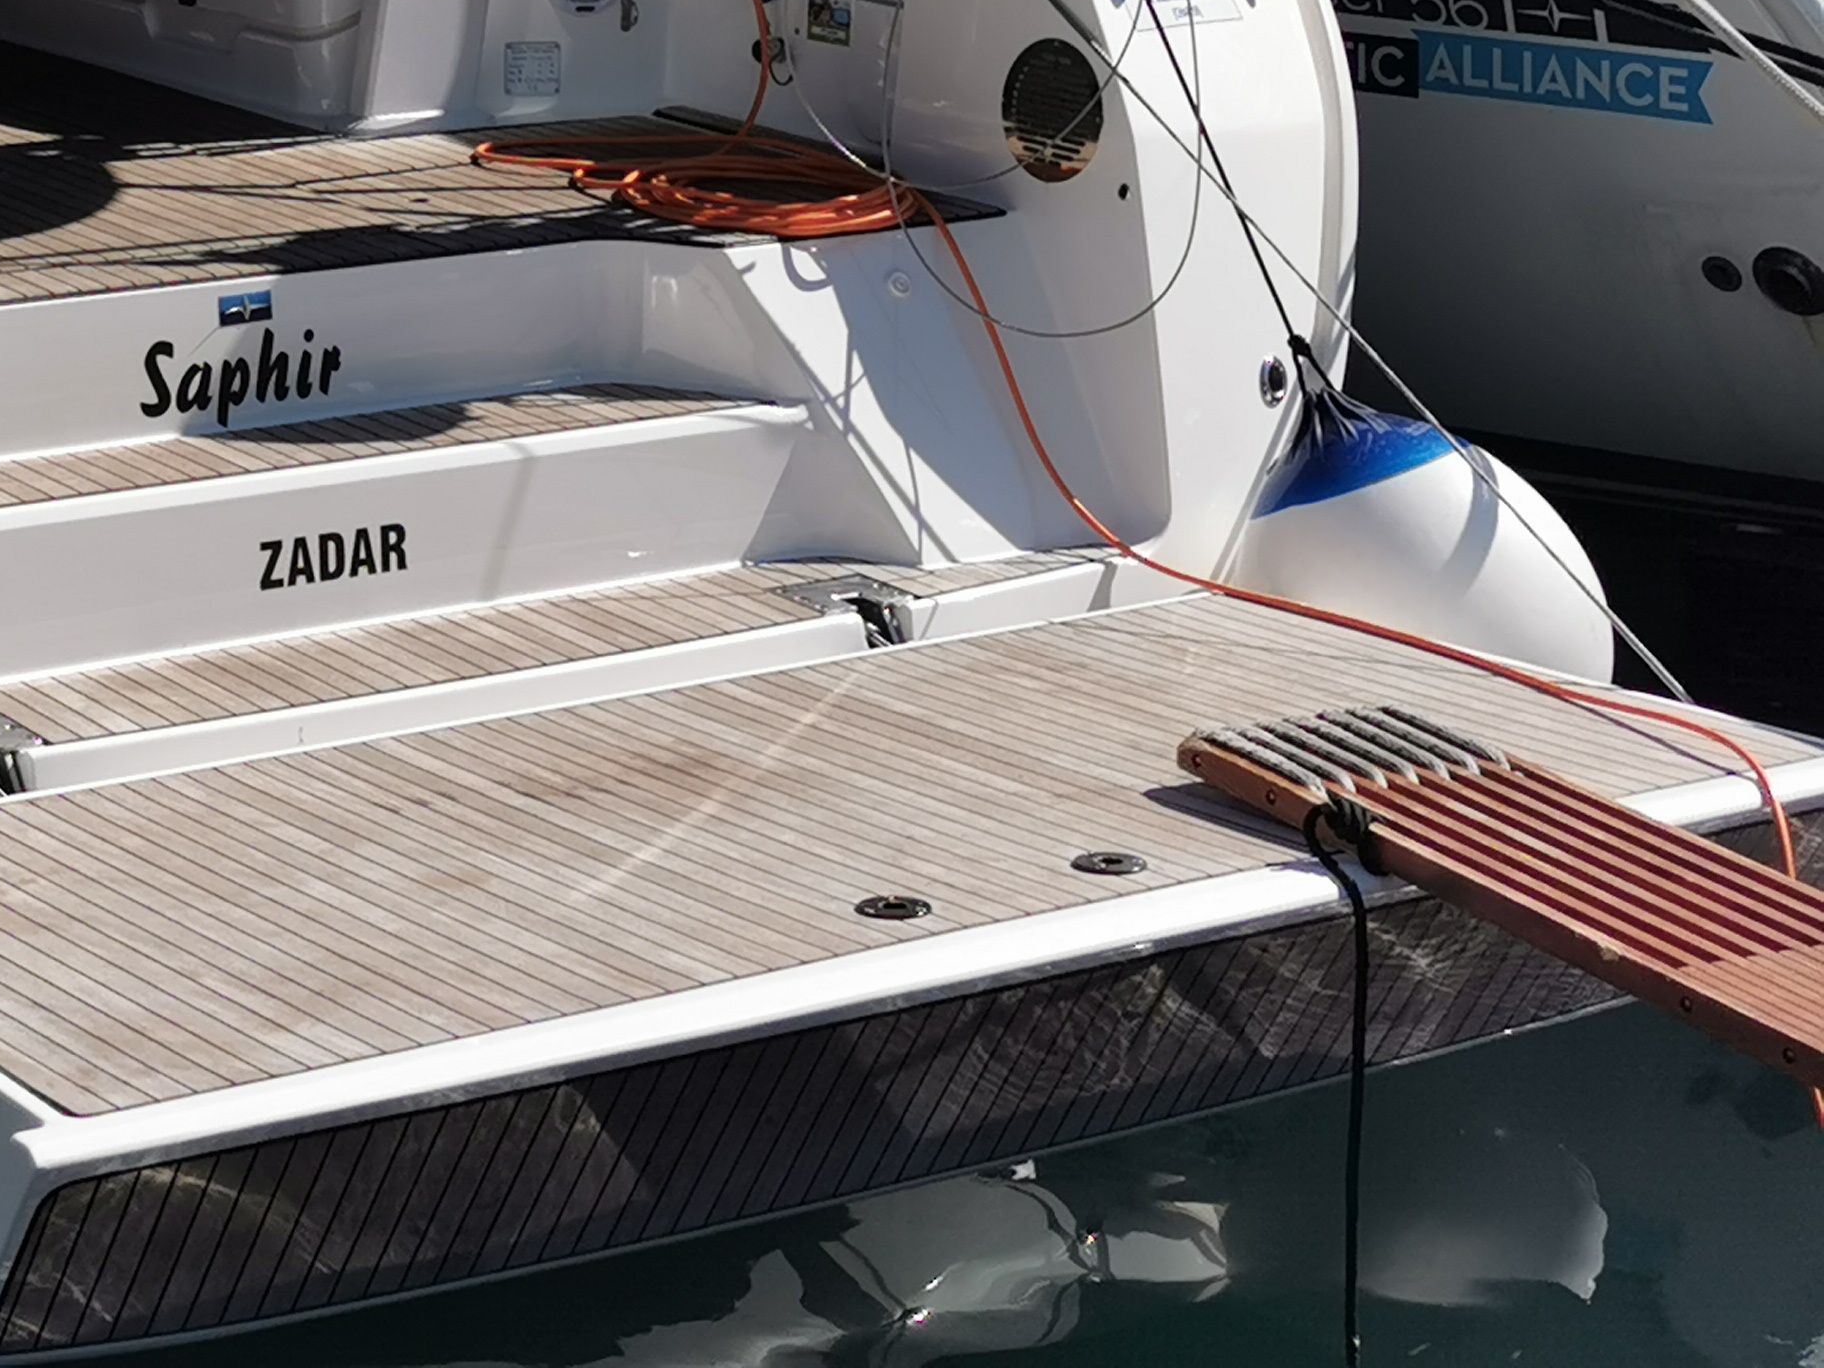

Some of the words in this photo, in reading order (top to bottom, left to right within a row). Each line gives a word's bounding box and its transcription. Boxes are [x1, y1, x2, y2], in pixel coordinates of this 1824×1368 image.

[1344, 40, 1406, 87] IC
[1425, 42, 1690, 112] ALLIANCE
[140, 327, 341, 427] Saphir
[259, 523, 408, 590] ZADAR
